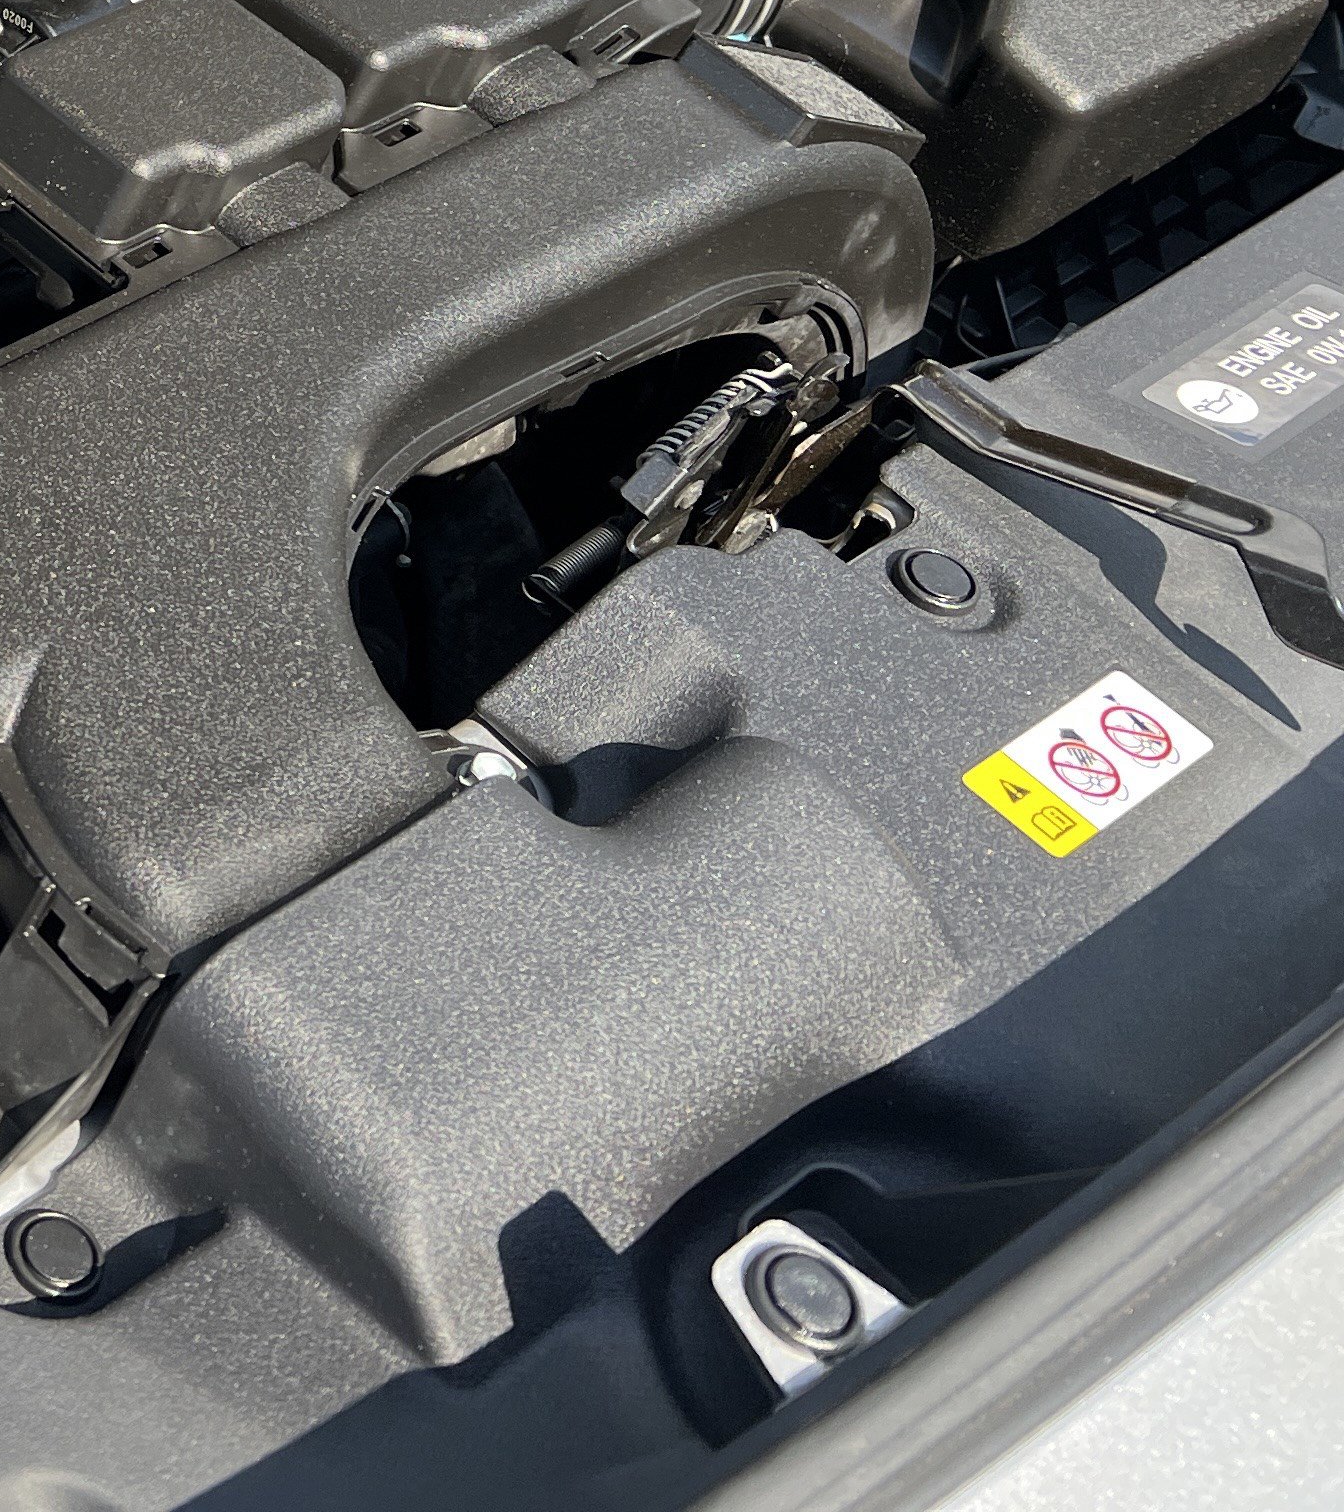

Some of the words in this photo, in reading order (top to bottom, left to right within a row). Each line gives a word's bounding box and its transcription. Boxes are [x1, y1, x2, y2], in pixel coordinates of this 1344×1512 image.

[2, 8, 34, 34] F0020
[1217, 326, 1302, 378] ENGINE
[1291, 306, 1341, 330] OIL
[1260, 361, 1318, 396] SAE
